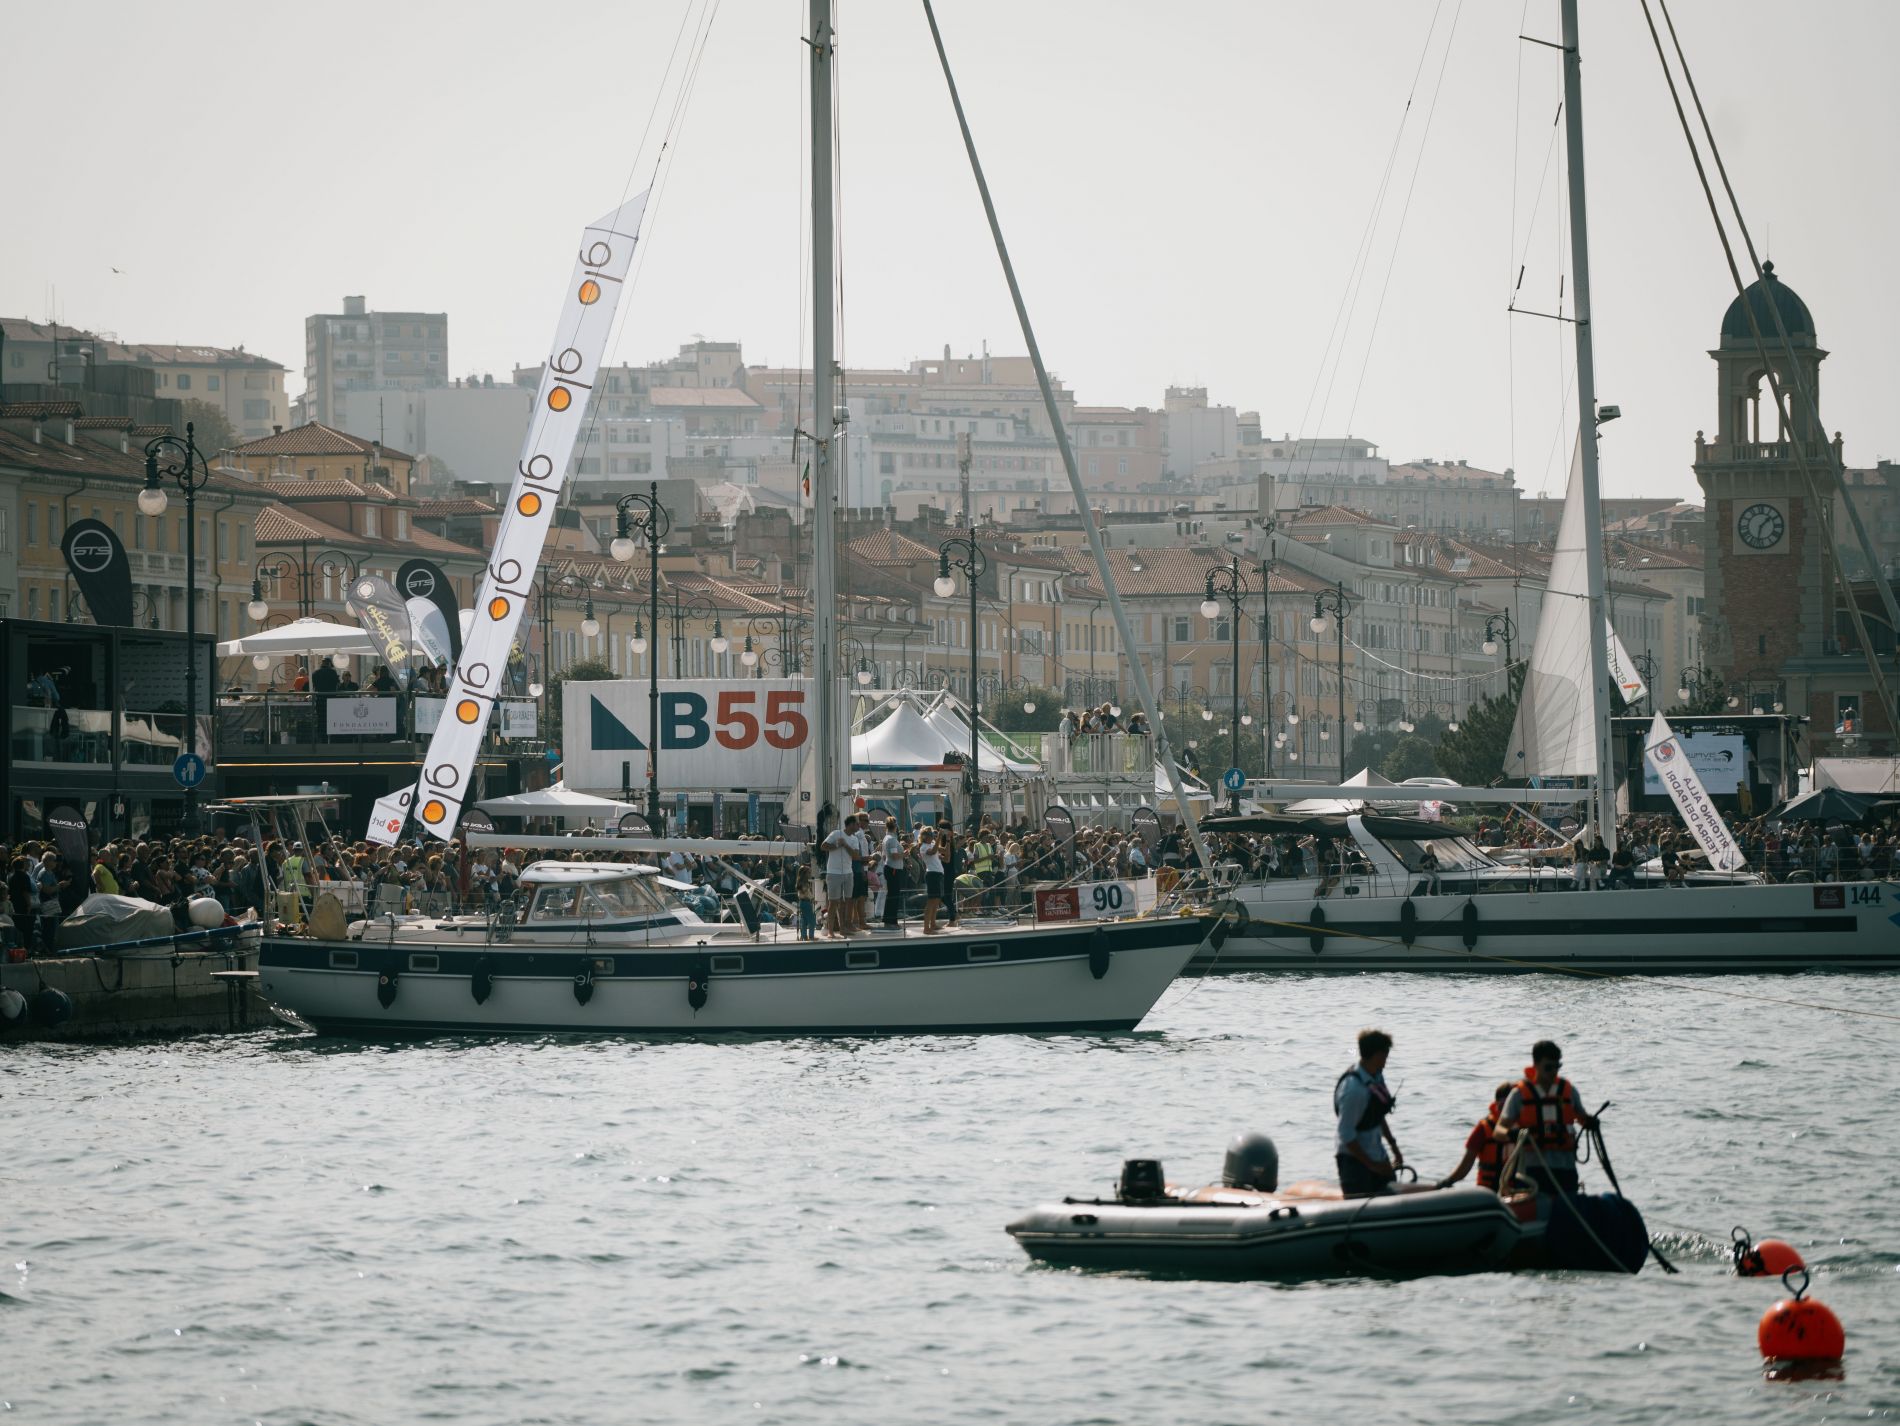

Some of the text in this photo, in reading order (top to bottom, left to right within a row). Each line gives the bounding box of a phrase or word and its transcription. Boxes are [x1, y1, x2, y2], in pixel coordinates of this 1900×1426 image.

[578, 241, 623, 306] glo
[547, 347, 592, 412] glo
[516, 454, 560, 518] glo
[72, 546, 111, 556] GTS
[408, 578, 434, 589] GTS
[488, 558, 528, 622] glo
[456, 662, 498, 725] glo
[660, 691, 808, 750] B55
[422, 763, 462, 825] glo
[1093, 884, 1123, 912] 90
[1851, 886, 1881, 905] 144
